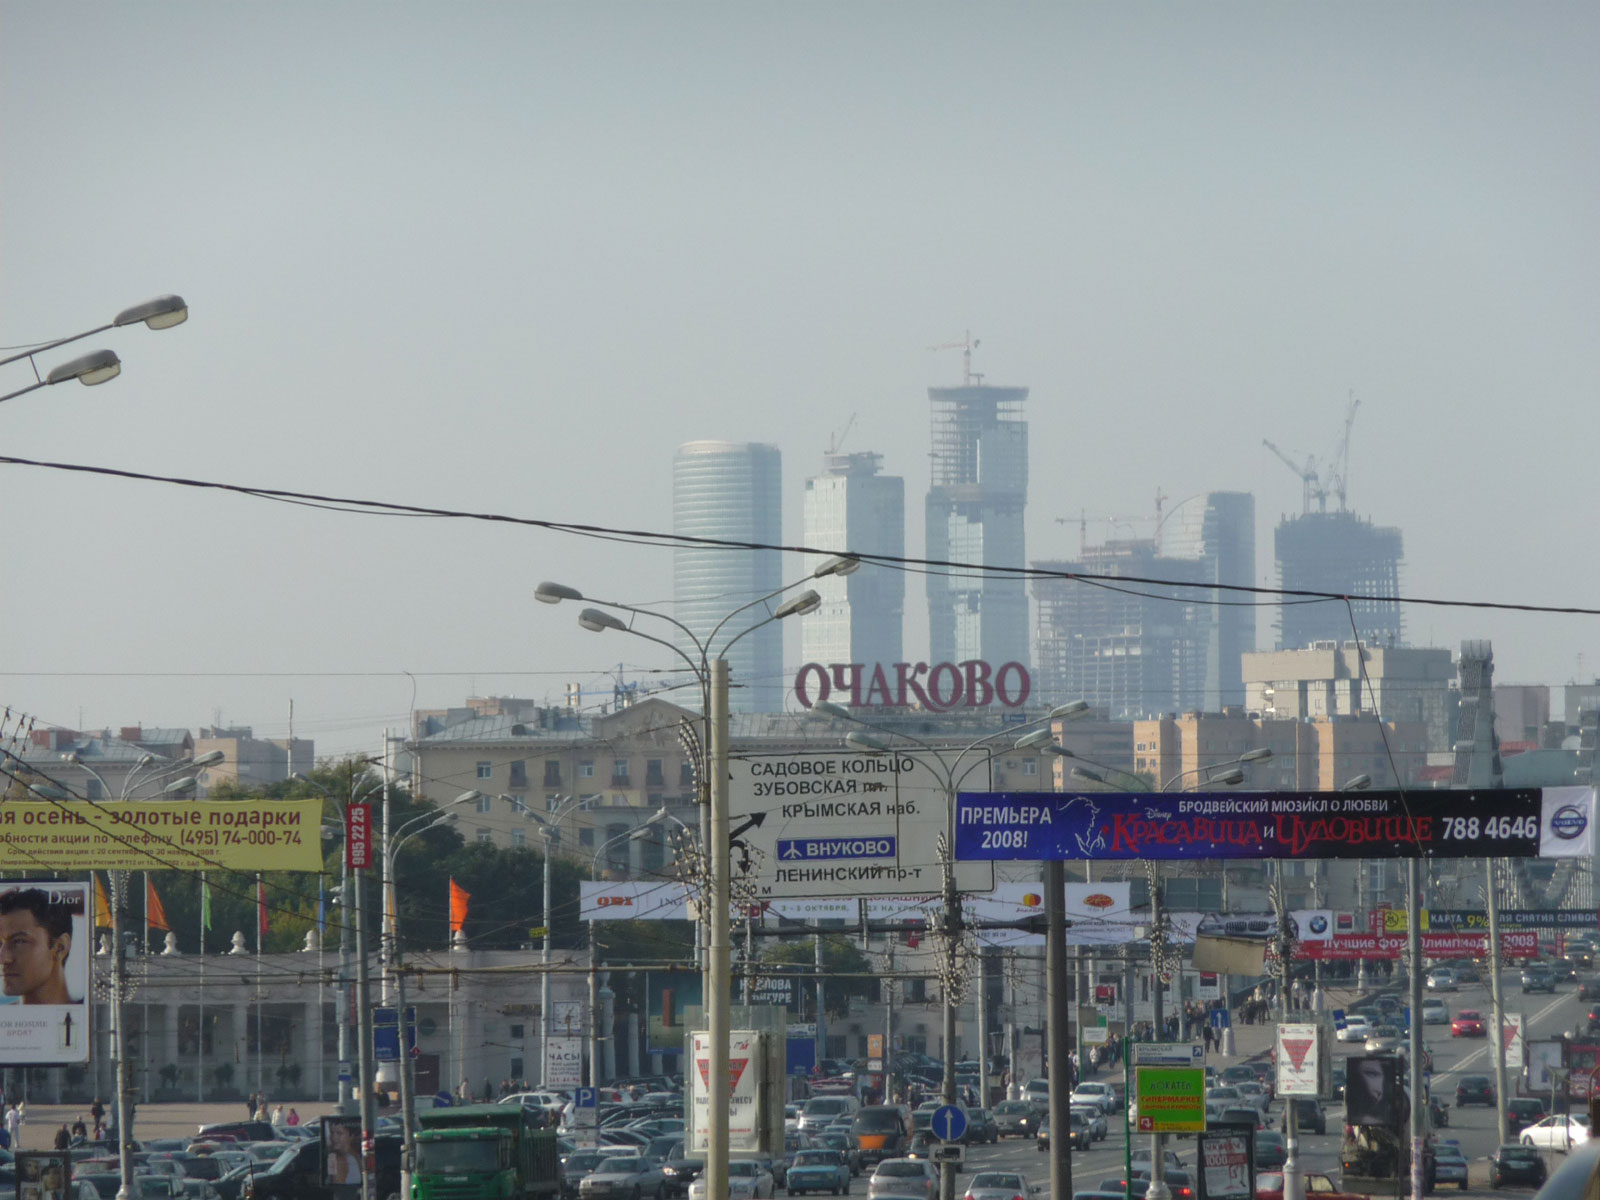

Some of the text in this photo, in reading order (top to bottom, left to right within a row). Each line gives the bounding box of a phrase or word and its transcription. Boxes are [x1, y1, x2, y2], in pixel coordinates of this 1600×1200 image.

[795, 660, 1031, 713] ОЧАКОВО
[751, 758, 914, 777] САДОВОЕ КОЛЬЦО
[753, 779, 857, 796] ЗУБОВСКАЯ
[782, 800, 920, 818] КРЫМСКАЯ наб.
[1145, 807, 1172, 821] Disney
[1179, 798, 1388, 814] БРОДВЕЙСКИЙ МЮЗИКЛ О ЛЮБВИ
[23, 810, 86, 825] осень
[109, 810, 202, 825] золотые
[209, 810, 301, 828] подарки
[961, 806, 1052, 825] ПРЕМЬЕРА
[1554, 818, 1585, 827] VOLVO
[1442, 816, 1537, 839] 788 4646
[51, 834, 90, 845] акции
[94, 835, 108, 844] по
[113, 834, 173, 846] телефону
[181, 829, 218, 846] (495)
[223, 830, 302, 846] 74-000-74
[351, 807, 366, 866] 995 22 25
[981, 831, 1028, 849] 2008!
[806, 840, 890, 856] ВНУКОВО
[775, 863, 922, 883] ЛЕНИНСКИЙ пр-т
[48, 890, 81, 904] Dior
[1431, 914, 1463, 924] КАРТА
[1515, 914, 1554, 923] СНЯТИЯ
[1557, 913, 1598, 923] СЛИВОК
[1322, 938, 1375, 950] Лучшие
[549, 1052, 580, 1061] ЧАСЫ
